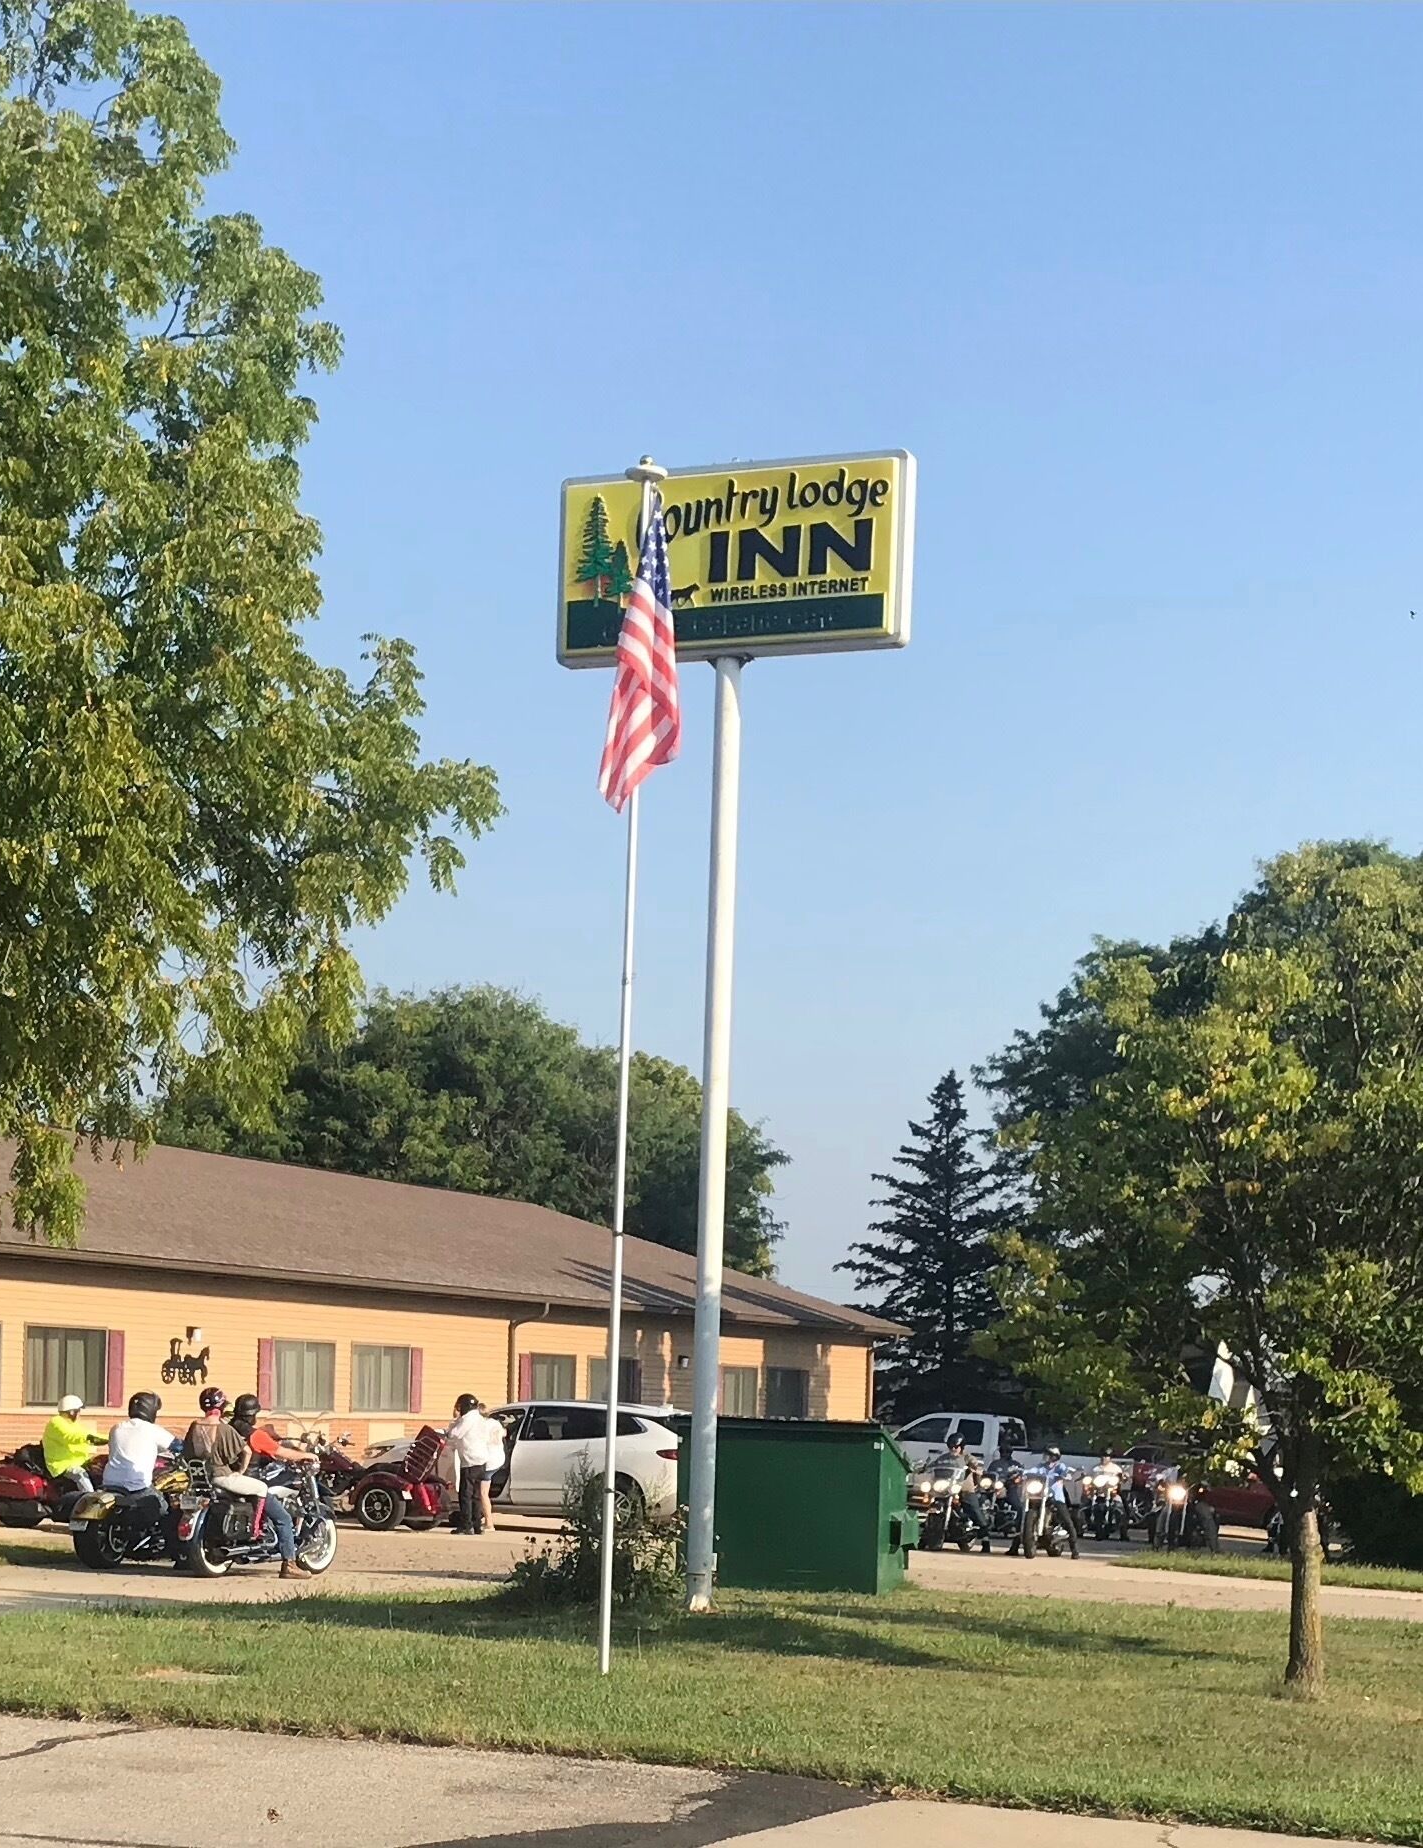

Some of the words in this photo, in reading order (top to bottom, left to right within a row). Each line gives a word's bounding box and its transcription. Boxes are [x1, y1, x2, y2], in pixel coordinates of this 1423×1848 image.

[636, 478, 779, 550] ountry
[708, 518, 874, 583] INN
[710, 582, 787, 603] WIRELESS
[792, 576, 869, 597] INTERNET
